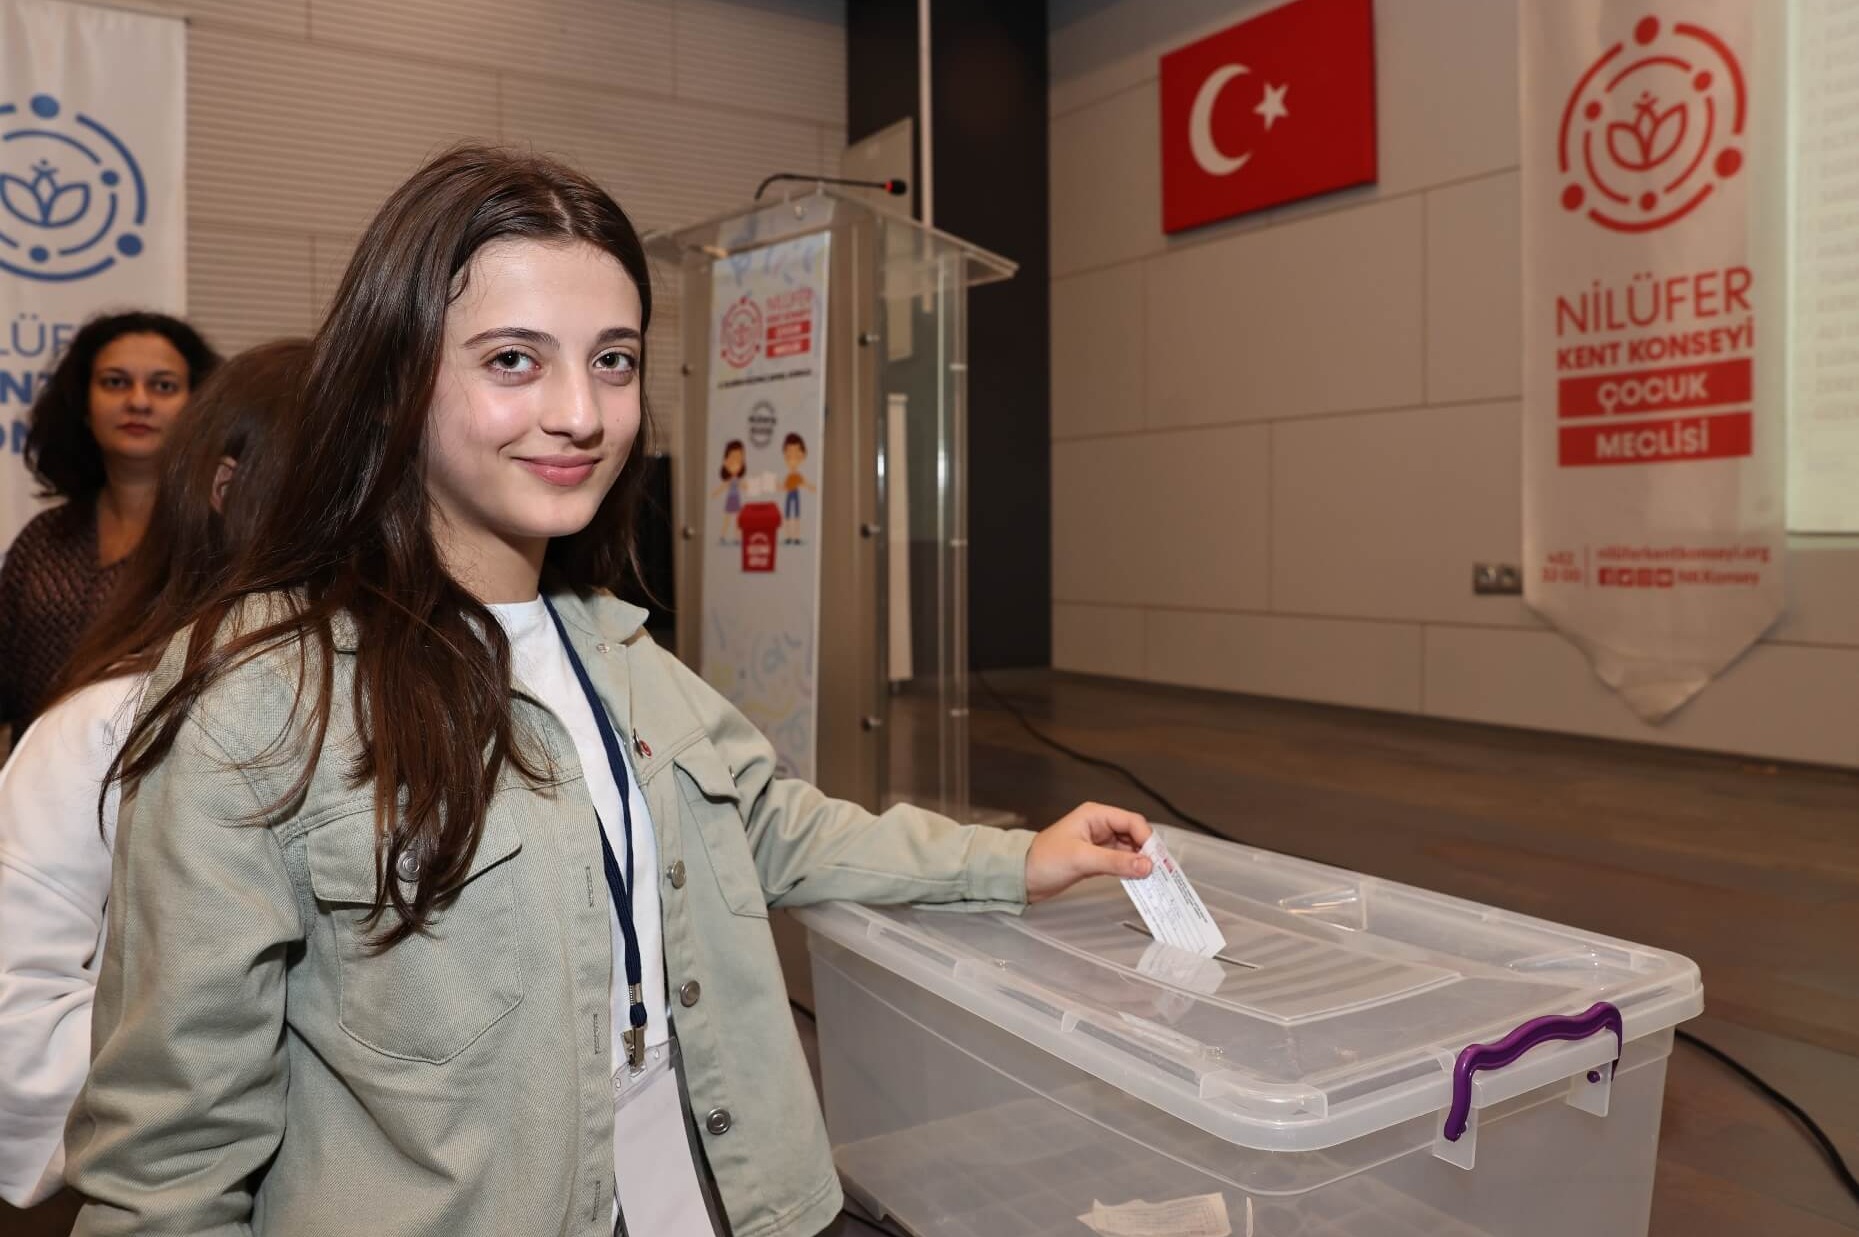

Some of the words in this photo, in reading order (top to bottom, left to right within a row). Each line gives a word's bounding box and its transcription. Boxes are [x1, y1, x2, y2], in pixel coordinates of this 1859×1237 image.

[1556, 265, 1754, 337] NİLÜFER
[1557, 341, 1622, 371] KENT
[1628, 317, 1755, 365] KONSEYİ
[1598, 372, 1709, 414] ÇOCUK
[1596, 419, 1709, 459] MECLİSİ
